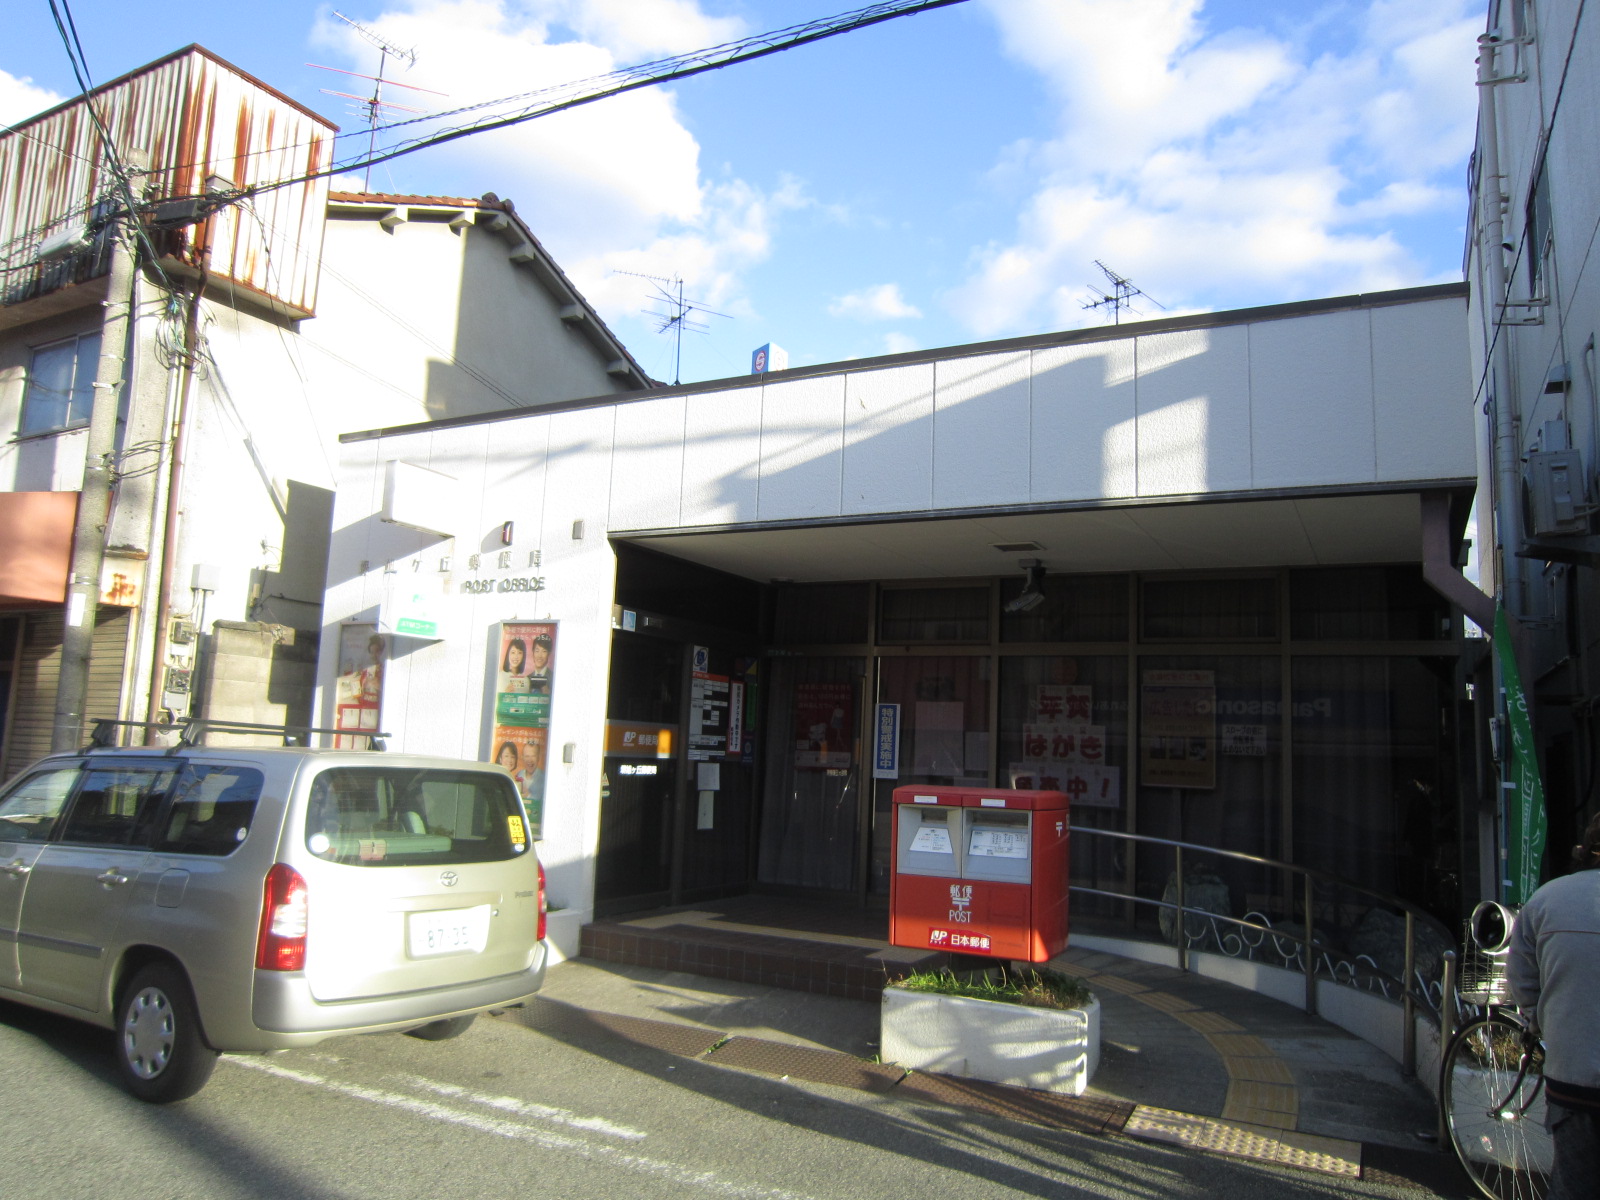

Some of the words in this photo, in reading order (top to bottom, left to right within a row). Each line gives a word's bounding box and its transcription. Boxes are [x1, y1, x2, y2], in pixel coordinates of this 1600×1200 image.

[465, 579, 496, 594] POST
[502, 576, 546, 593] OFFICE
[1038, 694, 1091, 720] 年賀
[880, 707, 894, 769] 特別警戒実施中
[1024, 733, 1103, 760] はがき
[949, 884, 973, 900] 郵便
[949, 909, 973, 923] POST
[950, 933, 990, 949] 日本郵便
